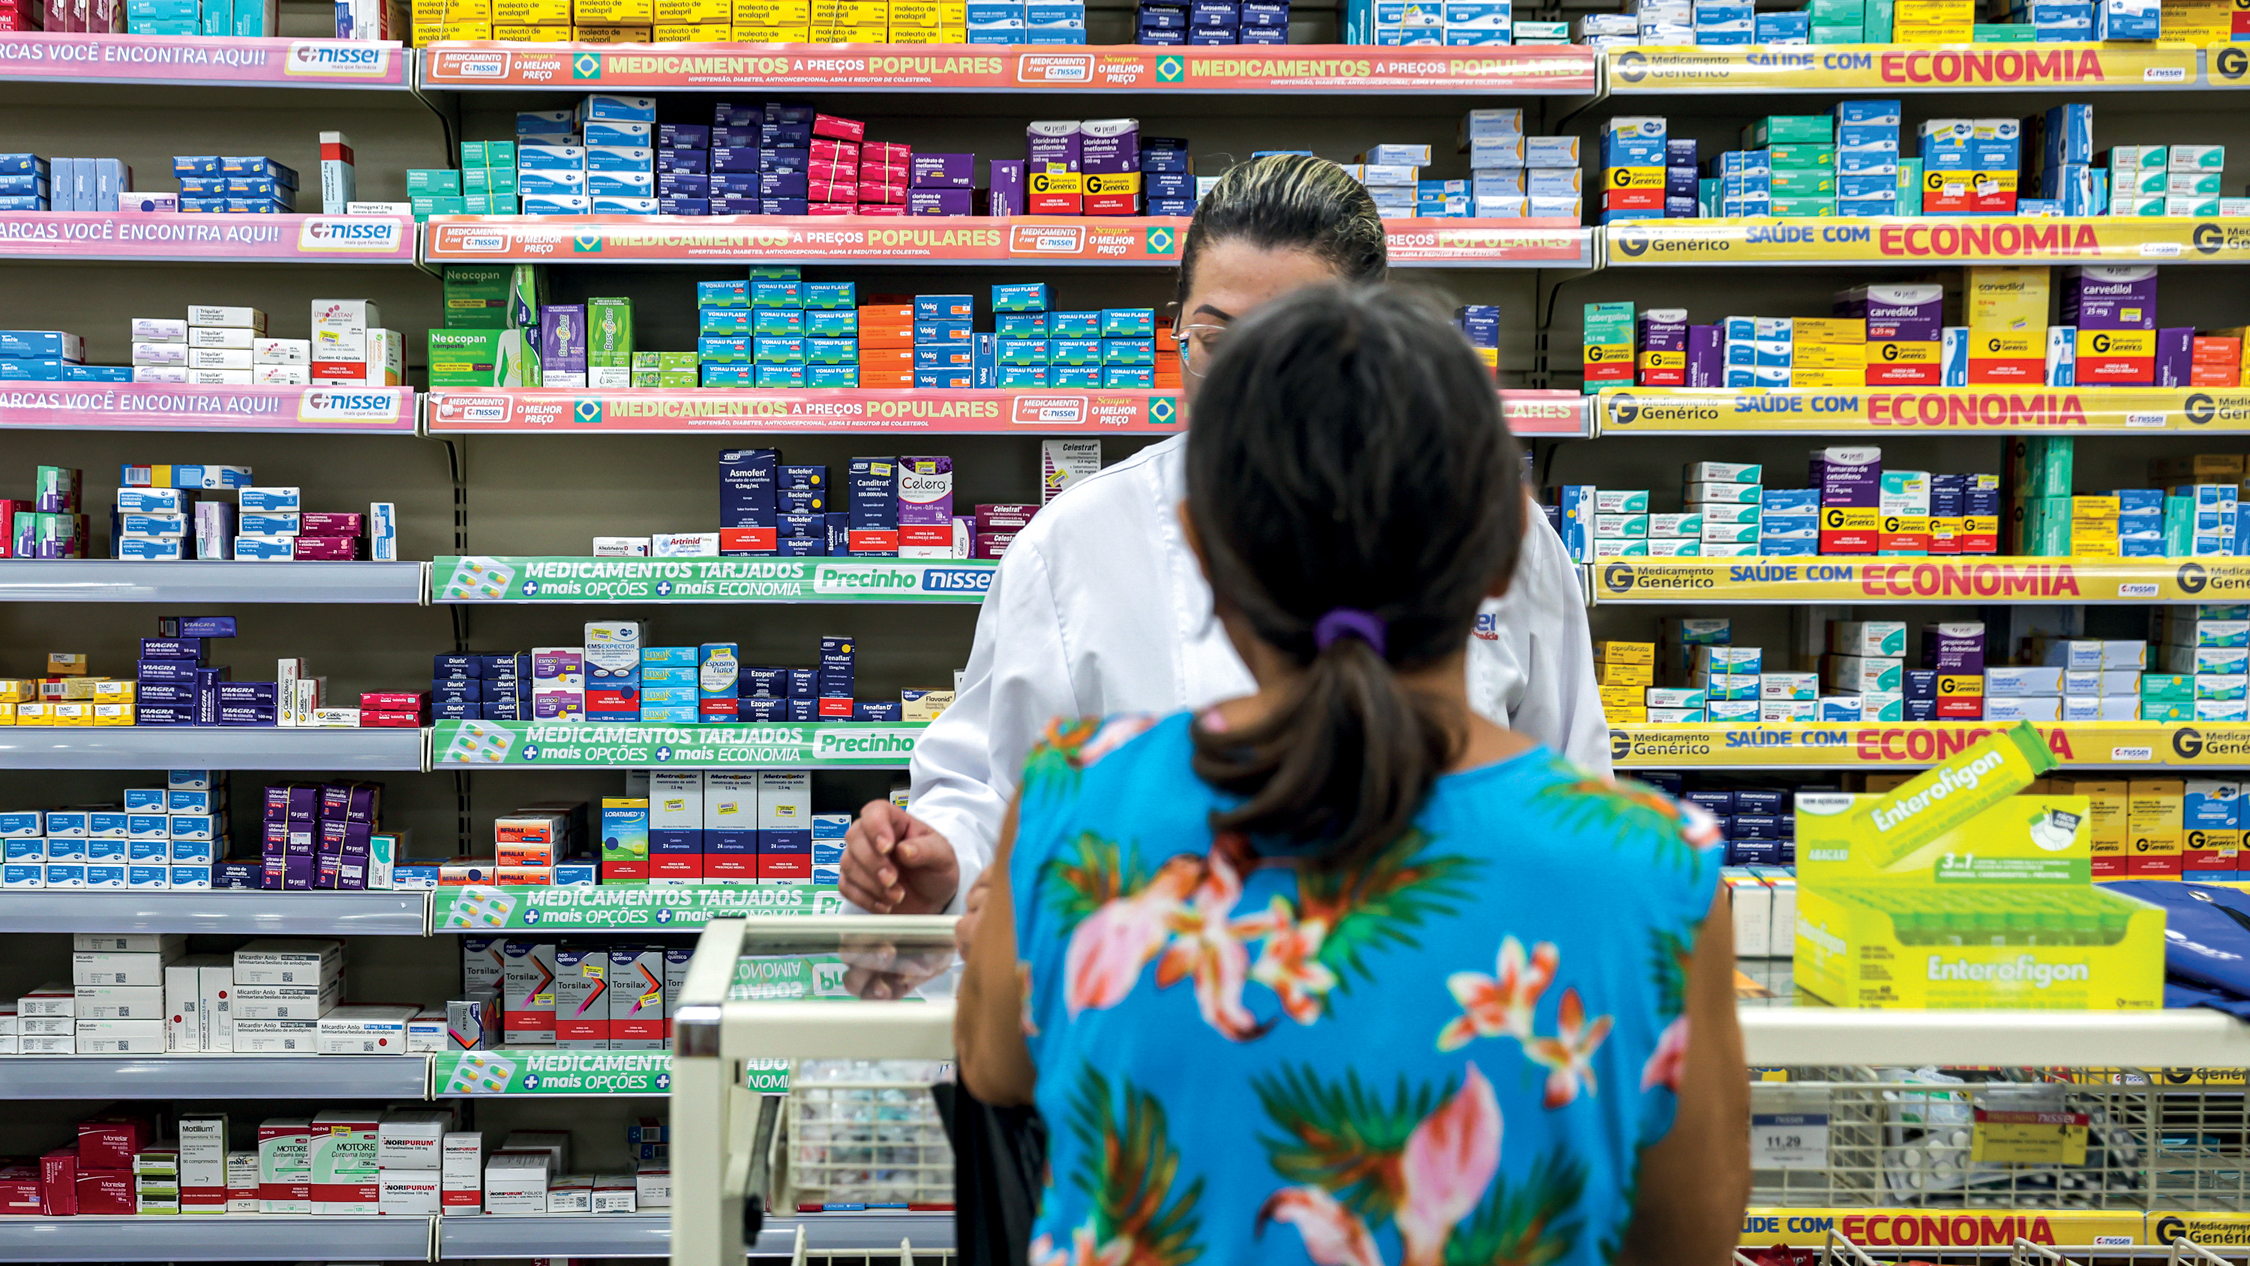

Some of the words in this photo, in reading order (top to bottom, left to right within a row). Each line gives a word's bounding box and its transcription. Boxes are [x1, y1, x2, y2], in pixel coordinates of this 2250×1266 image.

[498, 9, 530, 17] enalapril
[1201, 4, 1231, 12] furosemida
[48, 41, 99, 61] VOCÊ
[105, 46, 208, 65] ENCONTRA
[213, 49, 267, 67] AQUI!
[445, 53, 502, 62] MEDICAMENTO
[1103, 54, 1139, 63] Sempre
[514, 62, 523, 70] O
[524, 61, 562, 71] MELHOR
[608, 56, 790, 74] MEDICAMENTOS
[793, 59, 804, 71] A
[807, 59, 865, 74] PREÇOS
[868, 56, 1003, 75] POPULARES
[1029, 57, 1086, 65] MEDICAMENTO
[355, 63, 377, 71] farmácia
[1098, 65, 1105, 74] O
[1106, 64, 1144, 74] MELHOR
[1191, 60, 1371, 77] MEDICAMENTOS
[1374, 63, 1385, 74] A
[1389, 62, 1446, 77] PREÇOS
[1450, 59, 1585, 77] POPULARES
[522, 70, 553, 81] PREÇO
[688, 75, 732, 83] HIPERTENSÃO,
[1106, 74, 1136, 85] PREÇO
[1052, 125, 1068, 133] prati
[1032, 137, 1058, 145] cloridrato
[0, 222, 58, 238] ARCAS
[63, 218, 114, 240] VOCÊ
[119, 225, 222, 242] ENCONTRA
[226, 225, 280, 243] AQUI!
[806, 232, 864, 246] PREÇOS
[867, 229, 1001, 247] POPULARES
[1745, 221, 1815, 243] SAÚDE
[1822, 225, 1871, 243] COM
[1879, 223, 2102, 256] ECONOMIA
[2083, 284, 2132, 295] carvedilol
[920, 303, 937, 312] Volig
[1870, 306, 1918, 318] carvedilol
[2086, 306, 2096, 315] 25
[2096, 308, 2108, 317] mg
[1587, 313, 1631, 324] cabergolina
[603, 308, 614, 350] Buscopan
[432, 333, 487, 345] Neocopan
[65, 390, 115, 410] VOCÊ
[120, 394, 222, 412] ENCONTRA
[227, 396, 279, 413] AQUI!
[609, 400, 788, 417] MEDICAMENTOS
[792, 405, 803, 415] A
[805, 403, 863, 417] PREÇOS
[866, 400, 999, 418] POPULARES
[1642, 406, 1719, 420] Genérico
[1734, 393, 1802, 413] SAÚDE
[1810, 395, 1858, 412] COM
[1867, 393, 2088, 426] ECONOMIA
[1062, 443, 1096, 451] Celestrat
[729, 468, 765, 477] Asmofen
[1826, 465, 1856, 474] fumarato
[1858, 465, 1868, 473] de
[1826, 473, 1861, 481] cetotifeno
[857, 479, 889, 487] Canditrat
[902, 476, 946, 493] Celerg
[670, 537, 701, 546] Artrinid
[524, 562, 693, 578] MEDICAMENTOS
[698, 562, 805, 579] TARJADOS
[1637, 567, 1714, 576] Medicamento
[821, 569, 916, 592] Precinho
[1637, 576, 1715, 589] Genérico
[1729, 560, 1798, 582] SAÚDE
[1805, 565, 1853, 582] COM
[1862, 564, 2081, 596] ECONOMIA
[541, 581, 582, 595] mais
[585, 580, 648, 600] OPÇÕES
[675, 581, 715, 595] mais
[718, 581, 801, 596] ECONOMIA
[705, 660, 735, 668] Espasmo
[644, 668, 671, 678] EnxaK
[751, 670, 775, 679] Ezopen
[526, 726, 692, 744] MEDICAMENTOS
[697, 728, 803, 744] TARJADOS
[1725, 725, 1793, 748] SAÚDE
[1800, 731, 1847, 748] COM
[821, 734, 915, 753] Precinho
[1634, 742, 1710, 756] Genérico
[541, 745, 581, 759] mais
[584, 744, 648, 765] OPÇÕES
[674, 746, 714, 761] mais
[717, 748, 801, 762] ECONOMIA
[1869, 749, 2005, 833] Enterofigon
[526, 890, 692, 907] MEDICAMENTOS
[696, 890, 803, 907] TARJADOS
[542, 909, 582, 924] mais
[586, 908, 649, 927] OPÇÕES
[674, 909, 714, 923] mais
[1927, 953, 2090, 987] Enterofigon
[557, 981, 592, 989] Torsilax
[182, 1125, 214, 1133] Motilium
[336, 1143, 376, 1151] MOTORE
[1766, 1135, 1802, 1149] 11,29
[1787, 1216, 1834, 1234] COM
[1842, 1215, 2056, 1247] ECONOMIA
